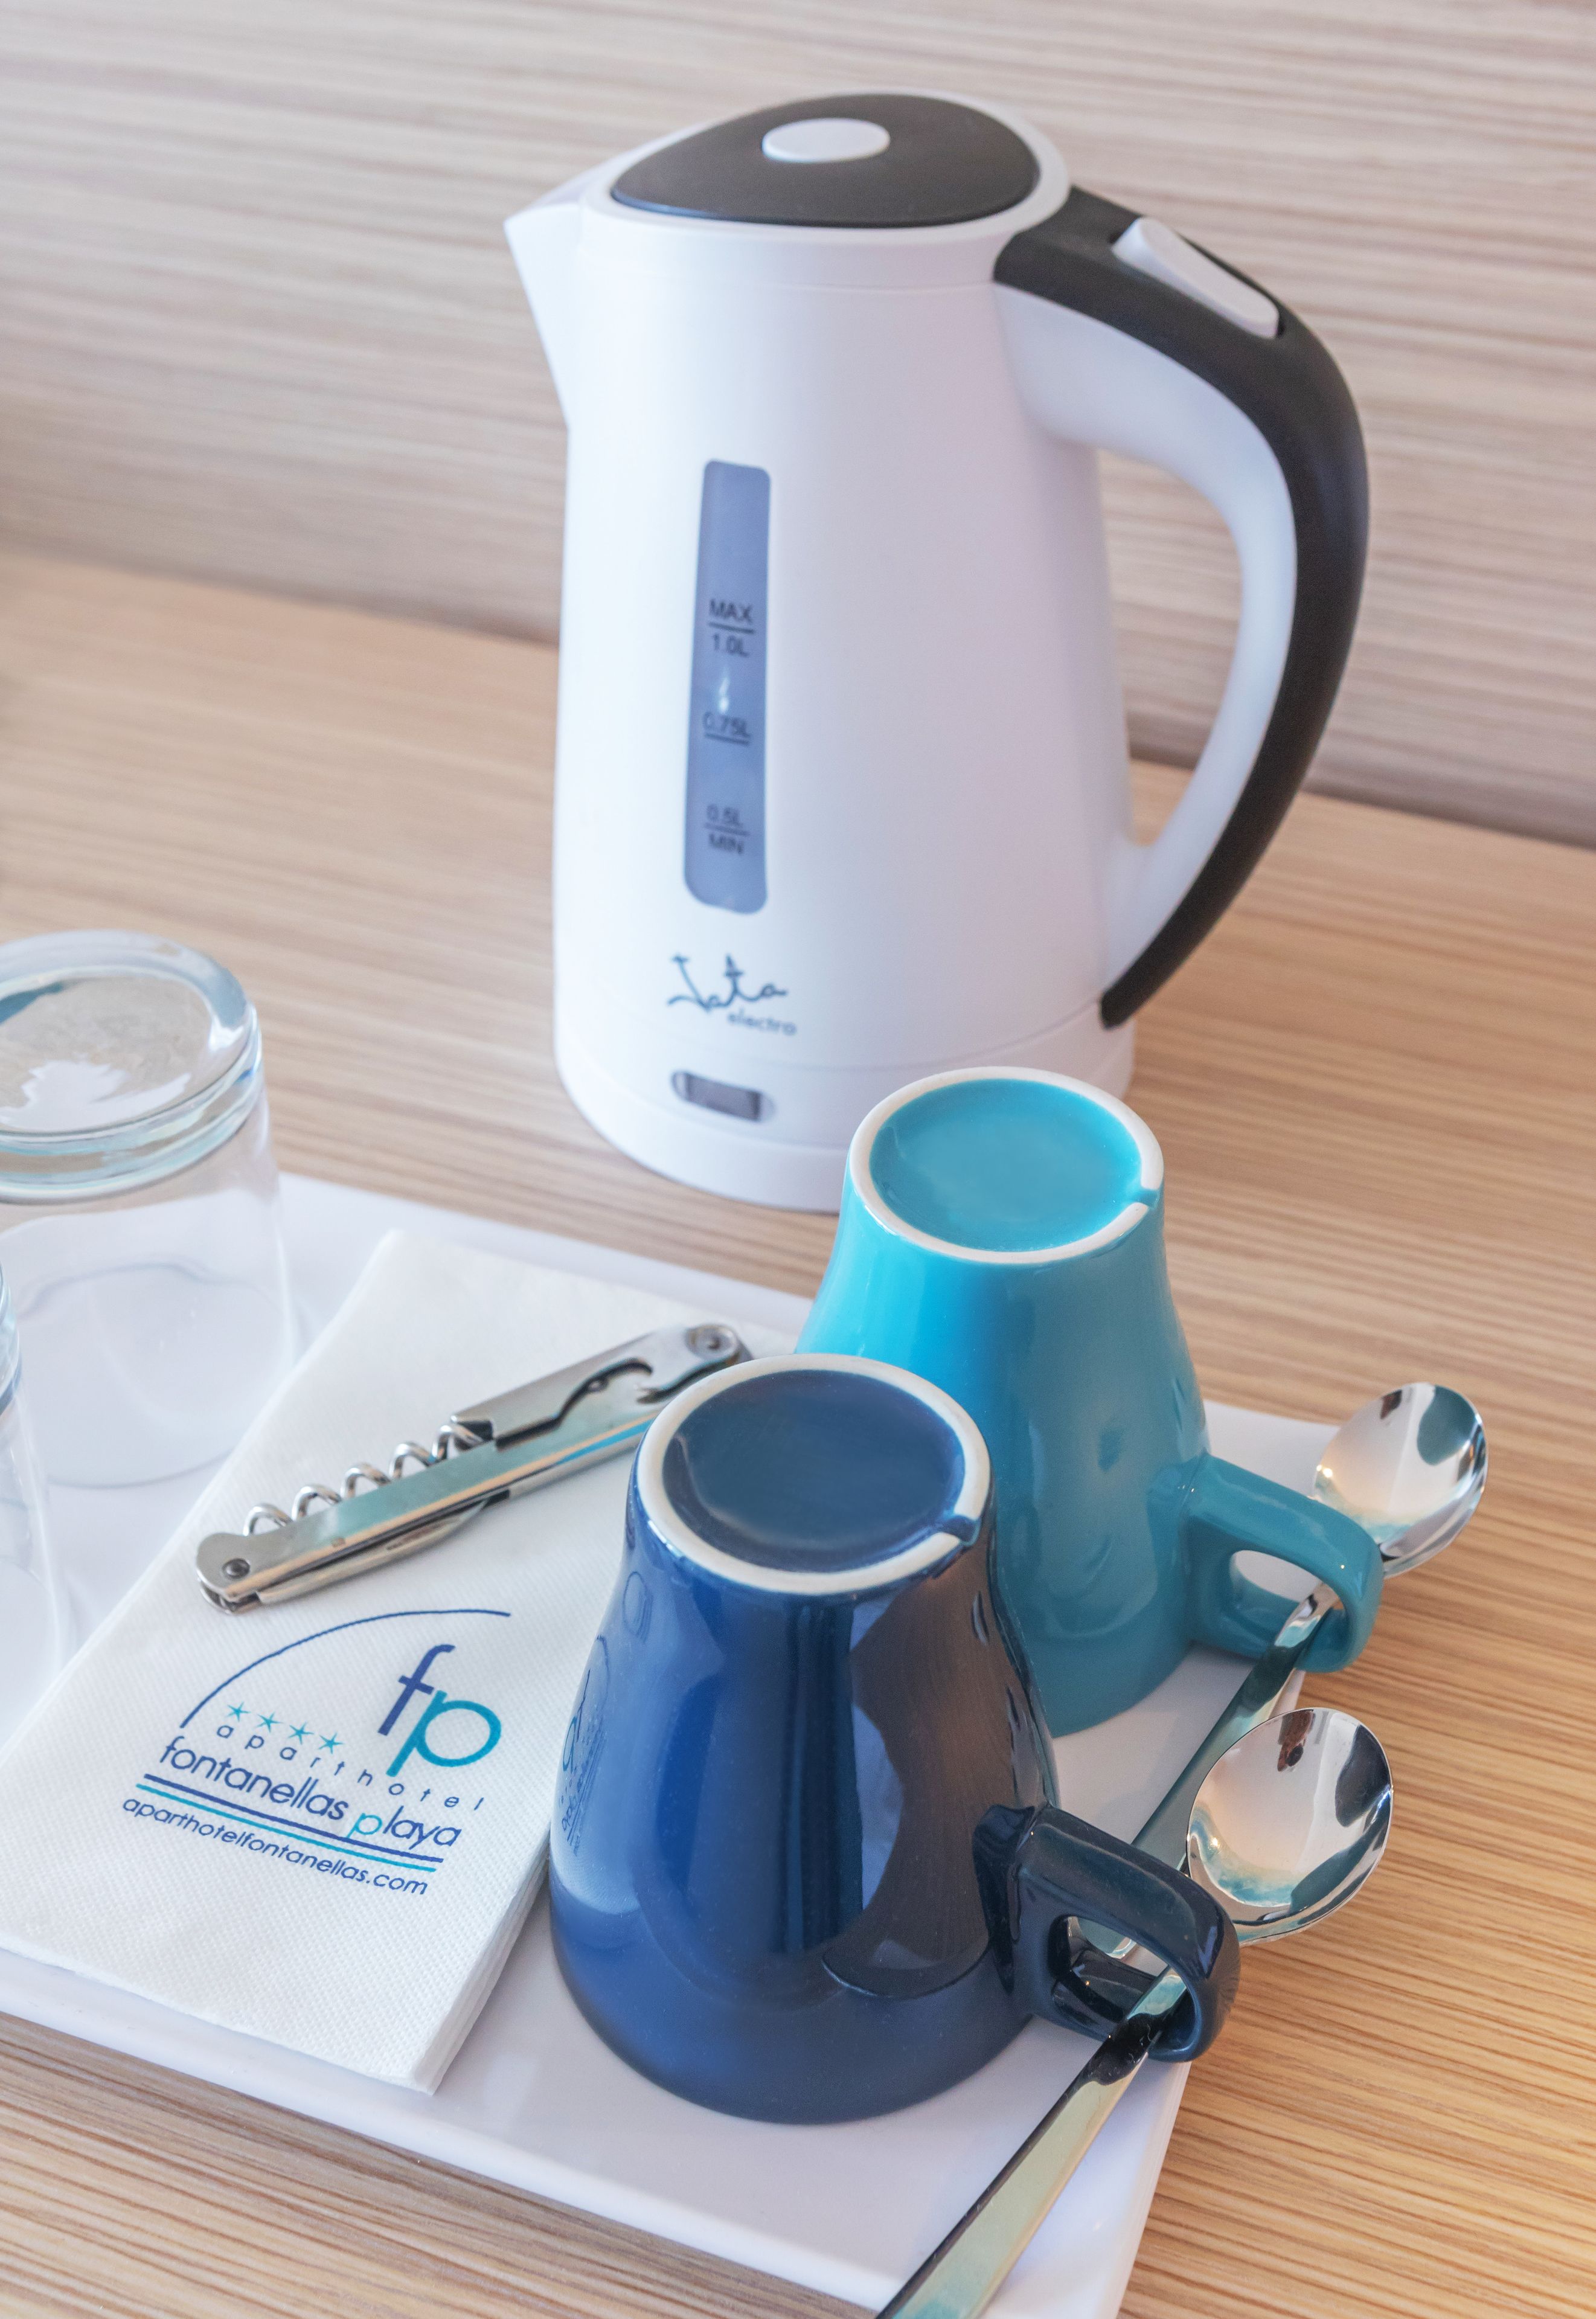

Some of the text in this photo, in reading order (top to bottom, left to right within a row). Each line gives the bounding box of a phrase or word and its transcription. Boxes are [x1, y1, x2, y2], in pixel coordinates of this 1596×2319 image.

[709, 599, 753, 623] MAX
[711, 634, 748, 656] 1.0L
[703, 712, 750, 738] 0.75L
[706, 804, 743, 827] 0.5L
[709, 833, 745, 856] MIN
[728, 1009, 797, 1036] electro
[377, 1644, 502, 1777] fp
[159, 1736, 463, 1850] fontanellas playa
[123, 1798, 428, 1896] aparthotelfontanellas.com
